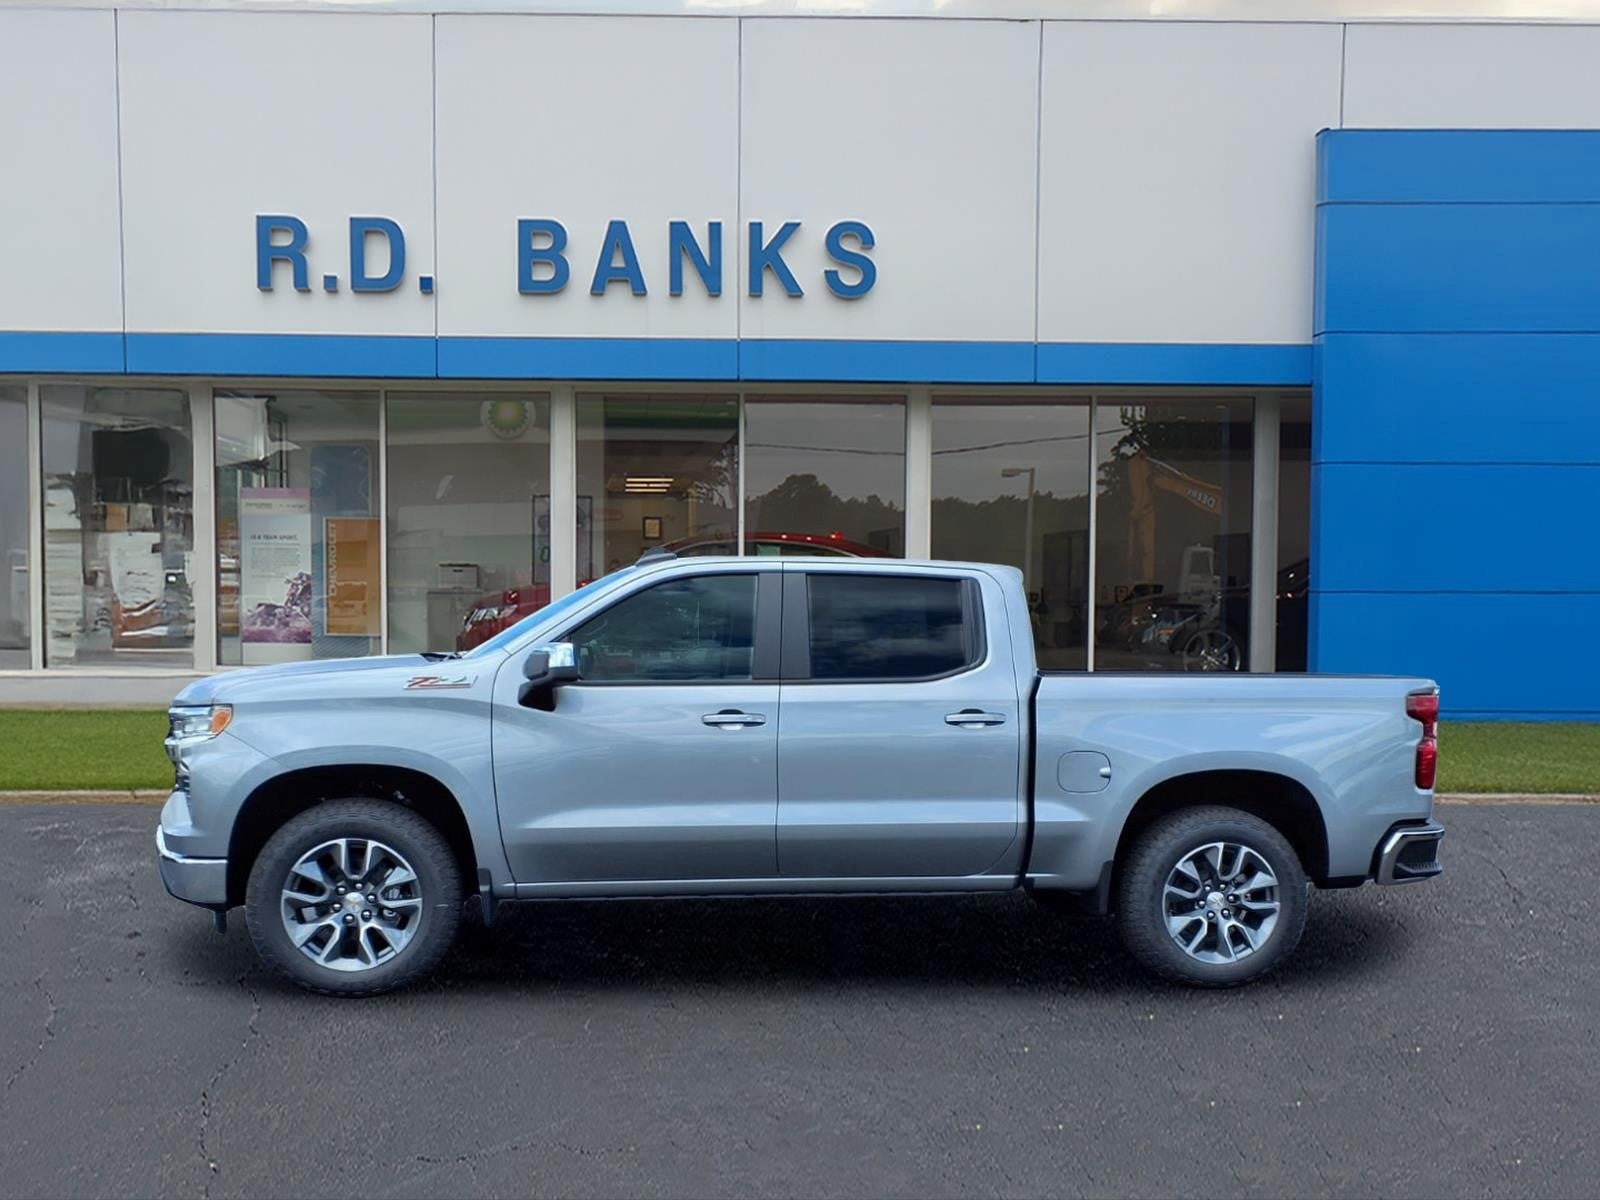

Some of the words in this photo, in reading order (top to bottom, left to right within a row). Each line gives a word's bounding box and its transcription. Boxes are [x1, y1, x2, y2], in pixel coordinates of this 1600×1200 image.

[256, 214, 435, 294] R.D.
[517, 218, 877, 300] BANKS
[328, 521, 336, 596] CHEVROLET
